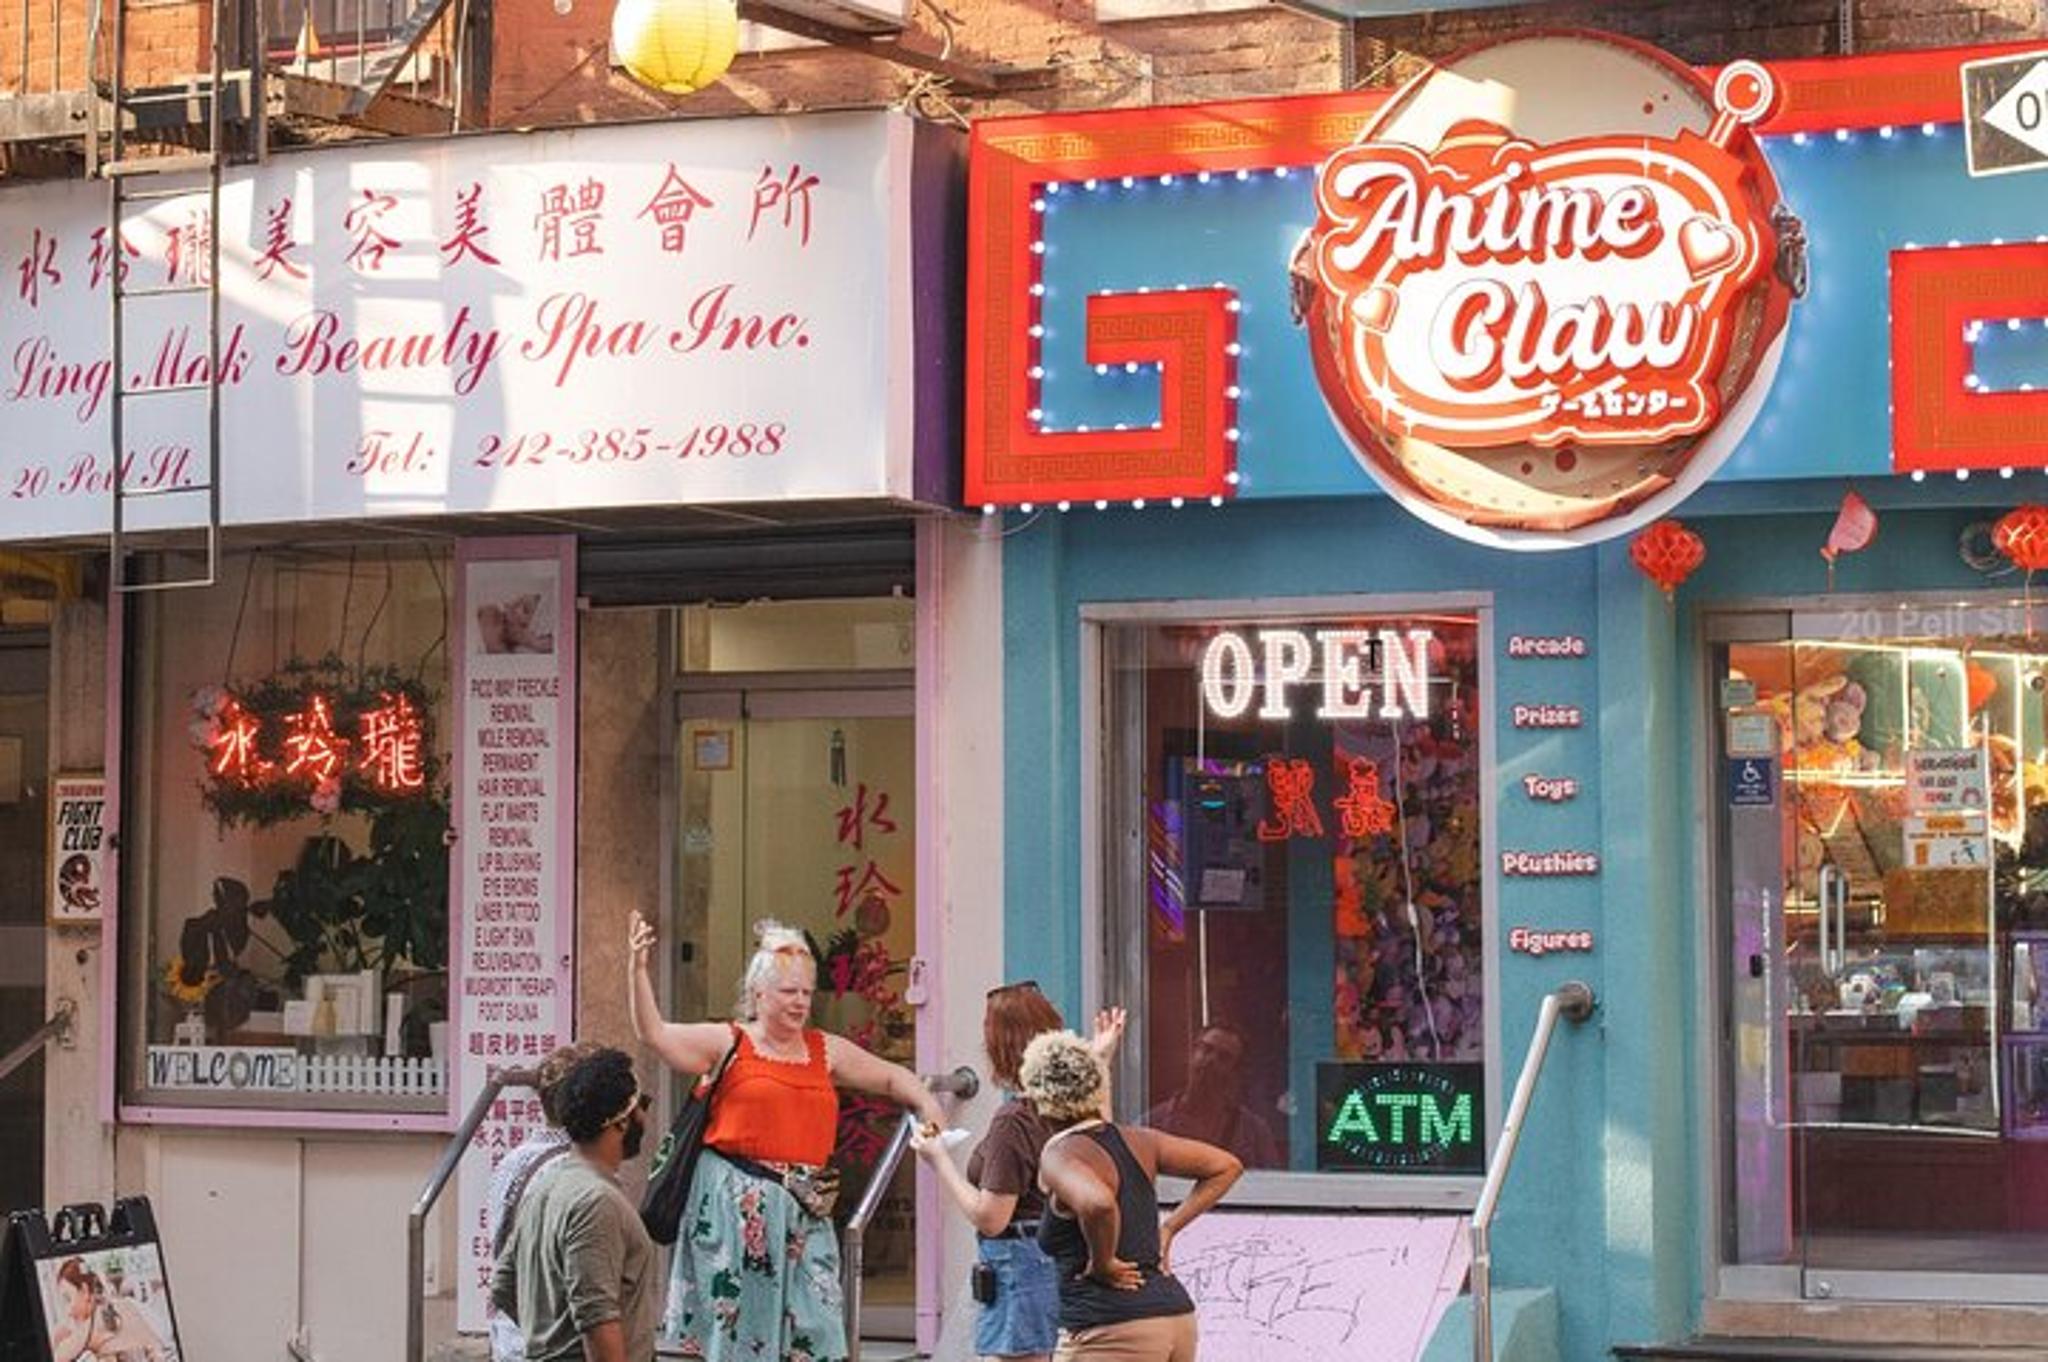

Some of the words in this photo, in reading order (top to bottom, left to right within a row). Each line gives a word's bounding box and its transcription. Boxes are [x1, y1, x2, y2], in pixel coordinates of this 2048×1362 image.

[2016, 91, 2048, 131] O
[1332, 160, 1662, 270] Anime
[1431, 279, 1700, 388] Claw
[5, 335, 112, 424] Ling
[275, 306, 504, 396] Beauty
[521, 292, 655, 388] Spa
[670, 284, 810, 354] Inc.
[346, 431, 434, 476] Tel:
[474, 423, 787, 468] 212-385-1988
[11, 466, 49, 499] 20
[1840, 610, 1882, 640] 20
[1897, 607, 1965, 638] Pell
[1509, 636, 1586, 657] Arcade
[1202, 630, 1432, 719] OPEN
[490, 704, 535, 722] REMOVAL
[1514, 705, 1581, 726] Prizes
[478, 727, 504, 748] MOLE
[506, 727, 550, 748] REMOVAL
[483, 753, 540, 773] PERMANENT
[478, 779, 499, 797] HAIR
[502, 779, 547, 798] REMOVAL
[1524, 774, 1577, 802] Toys
[63, 826, 103, 851] CLUB
[489, 827, 534, 847] REMOVAL
[1502, 852, 1598, 876] Plushies
[483, 878, 502, 897] EYE
[513, 927, 536, 947] SKIN
[1509, 928, 1593, 955] Figures
[151, 1051, 295, 1089] WELCOME
[1328, 1091, 1471, 1143] ATM
